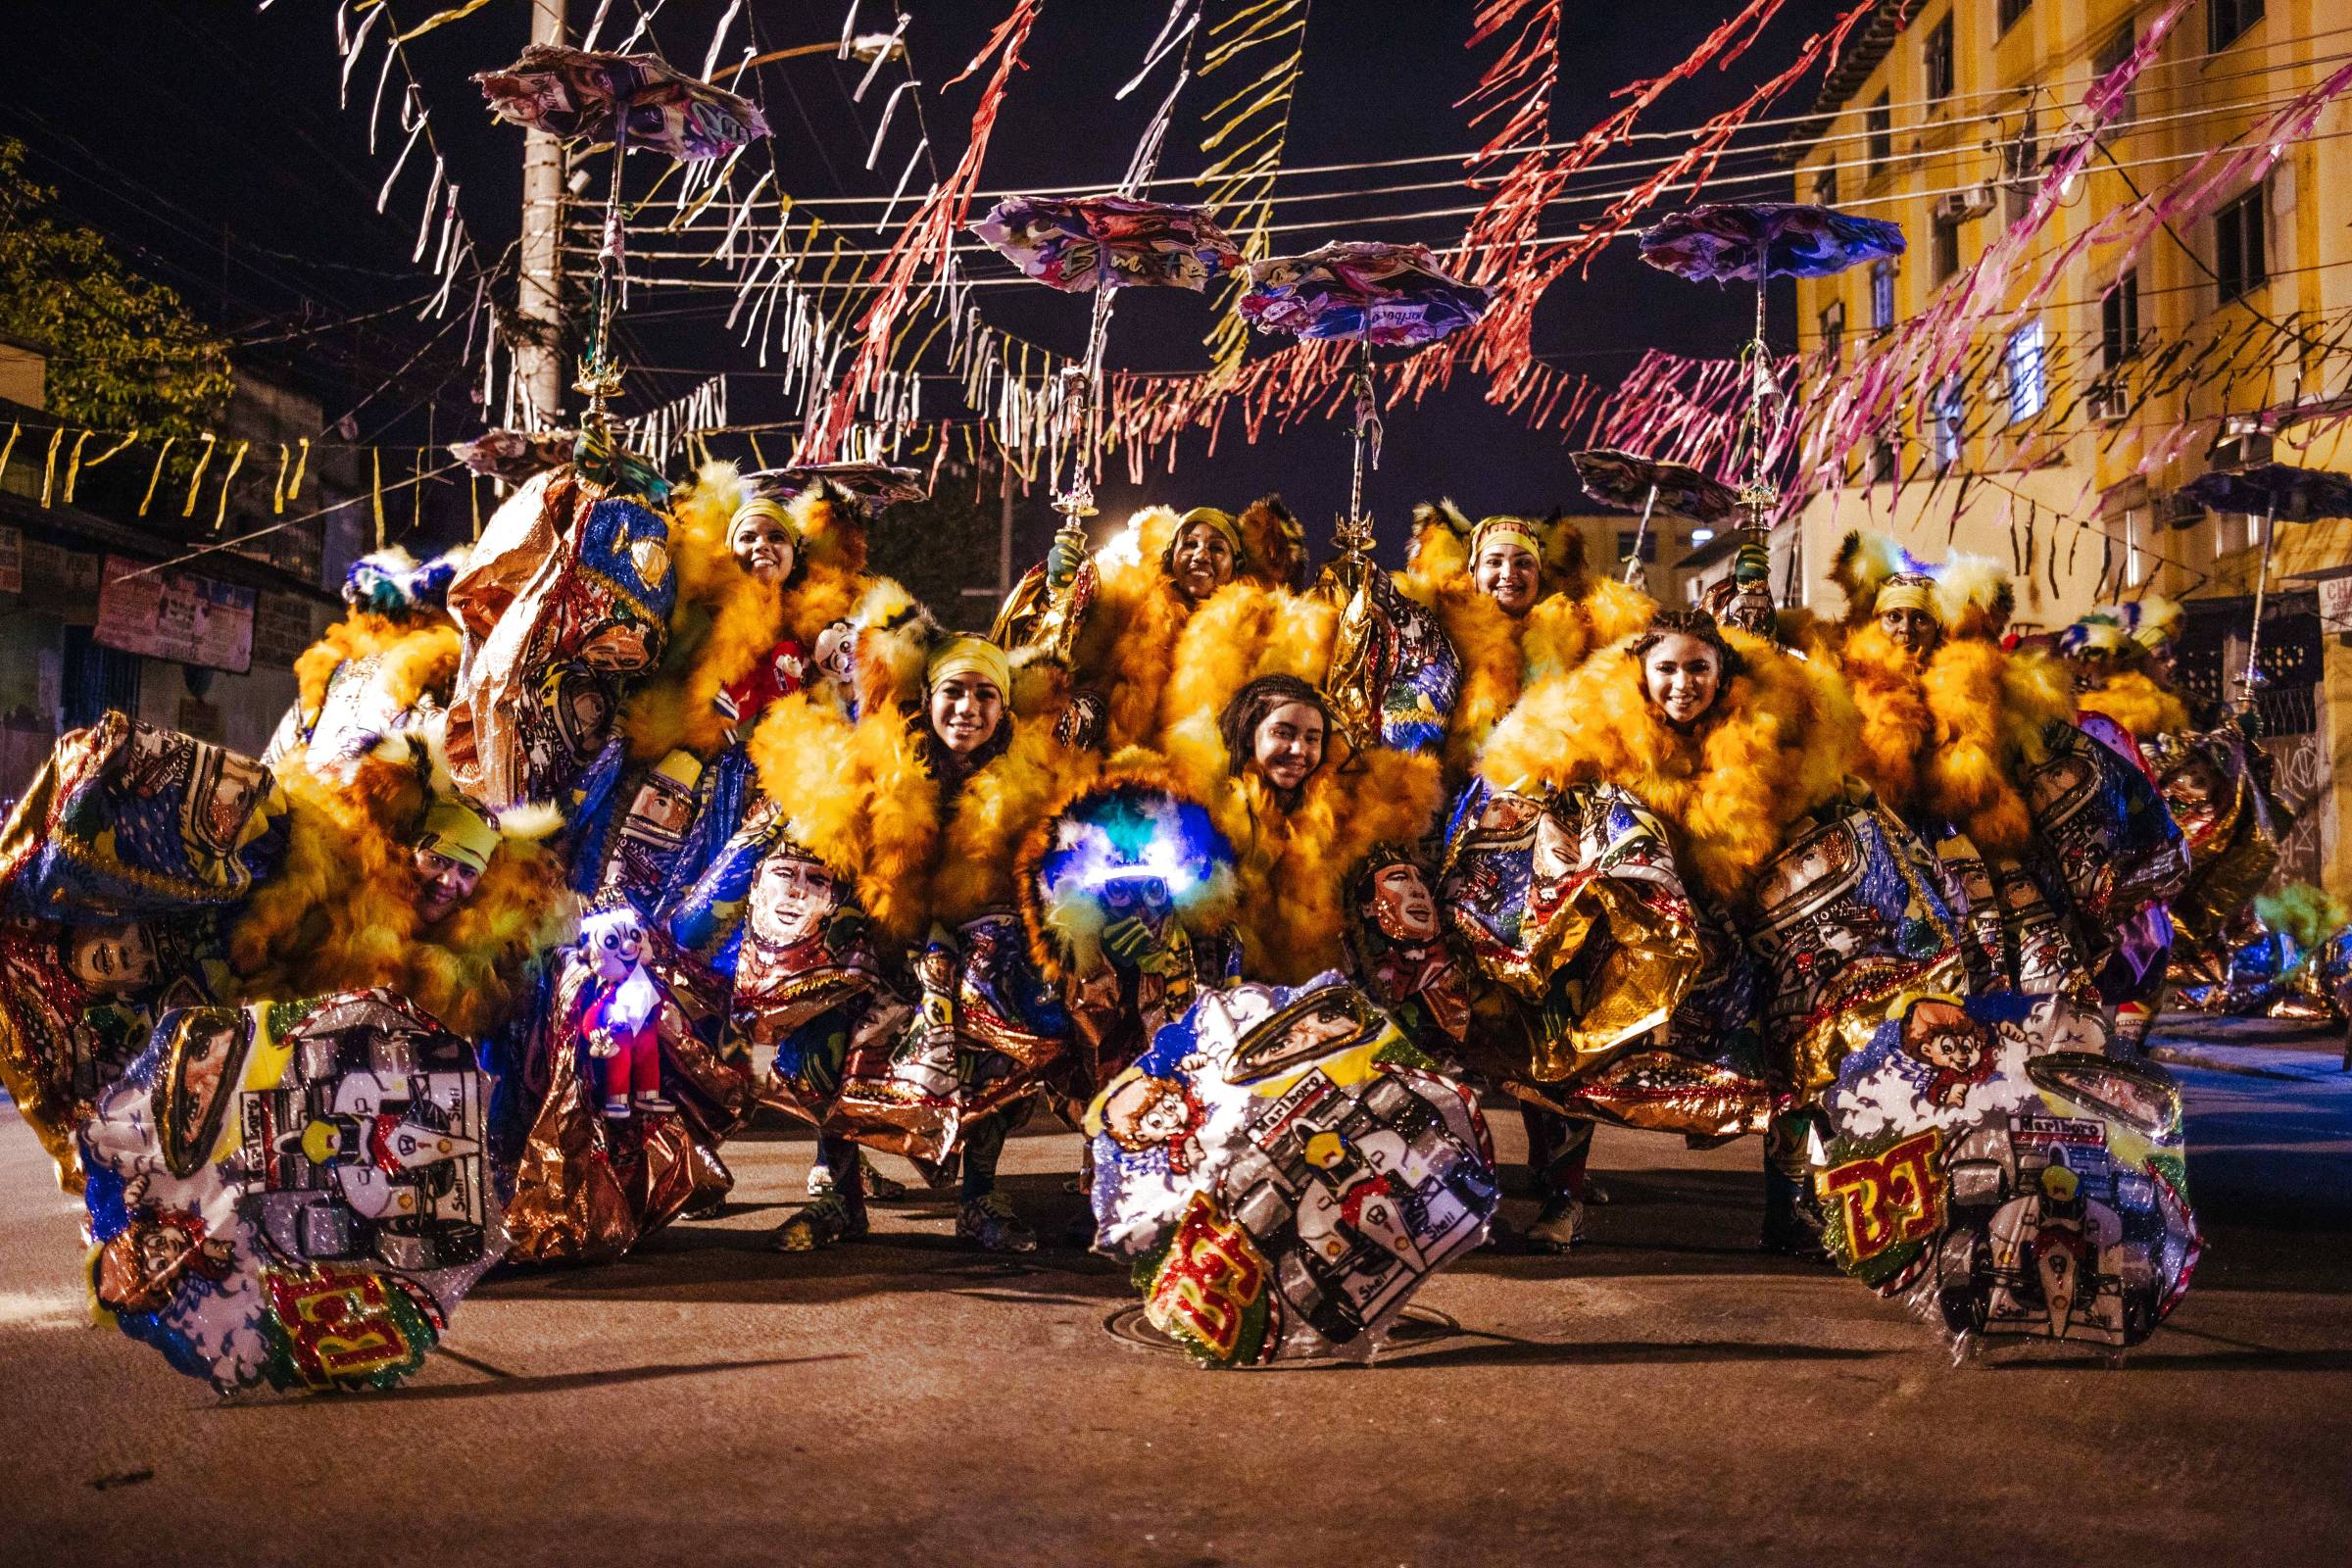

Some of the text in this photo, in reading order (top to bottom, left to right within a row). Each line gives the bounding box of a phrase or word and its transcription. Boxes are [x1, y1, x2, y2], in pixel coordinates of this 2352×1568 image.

[447, 1087, 461, 1122] Shell
[1253, 1073, 1324, 1135] Marlboro
[451, 1178, 466, 1212] Shell
[1425, 1211, 1455, 1238] Shell
